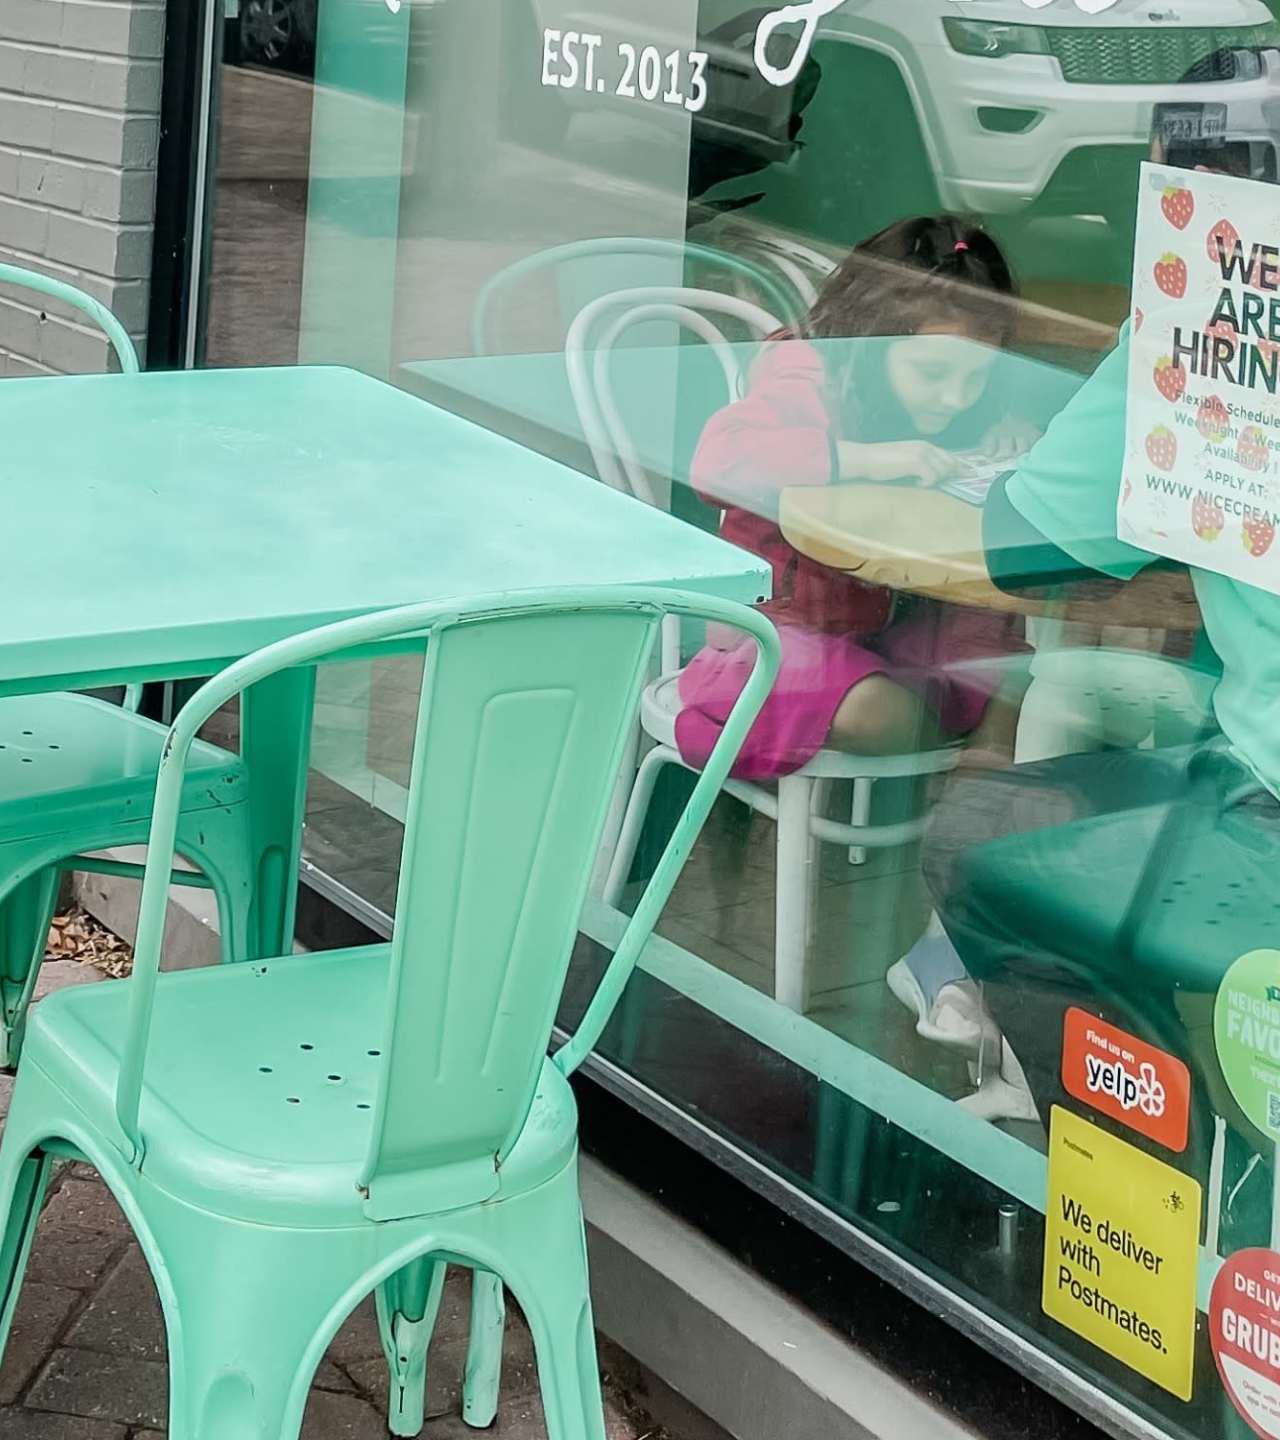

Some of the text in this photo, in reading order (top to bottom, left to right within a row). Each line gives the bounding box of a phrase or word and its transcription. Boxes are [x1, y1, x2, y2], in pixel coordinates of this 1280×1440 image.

[541, 28, 710, 112] EST. 2013
[1215, 235, 1280, 291] WE
[1175, 389, 1223, 410] Flexible
[1174, 412, 1239, 441] Weeknight
[1204, 469, 1245, 491] APPLY
[1086, 1029, 1108, 1052] Find
[1121, 1047, 1135, 1063] on
[1086, 1056, 1136, 1105] yelp
[1060, 1234, 1101, 1277] with
[1061, 1194, 1163, 1275] We deliver
[1057, 1265, 1168, 1355] Postmates.
